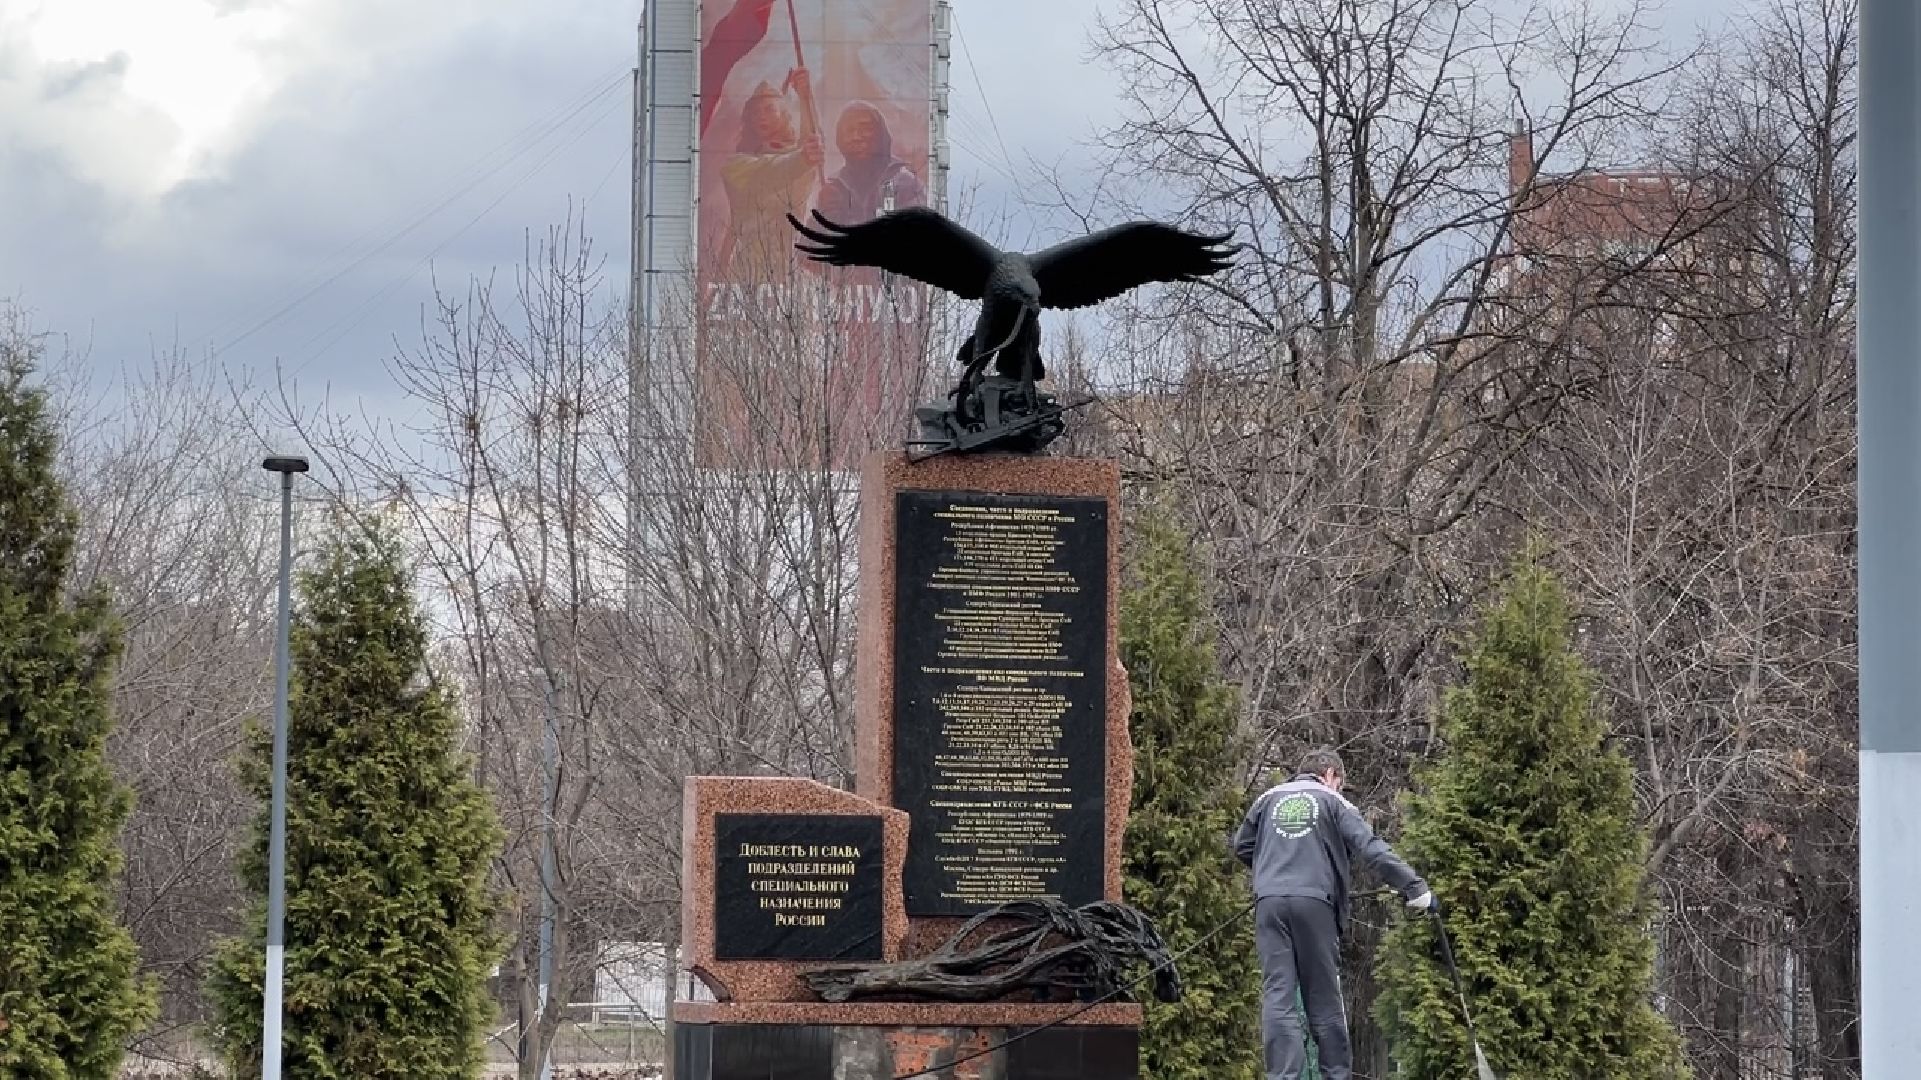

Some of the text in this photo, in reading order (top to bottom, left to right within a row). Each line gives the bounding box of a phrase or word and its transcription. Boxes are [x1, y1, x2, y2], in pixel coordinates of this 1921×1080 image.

[739, 843, 861, 858] ДОБЛЕСТЬ И СЛАВА
[748, 860, 855, 876] ПОДРАЗДЕЛЕНИЙ
[751, 880, 849, 892] СПЕЦИАЛЬНОГО
[760, 897, 841, 910] НАЗНАЧЕНИЯ
[775, 912, 826, 926] РОССИИ
